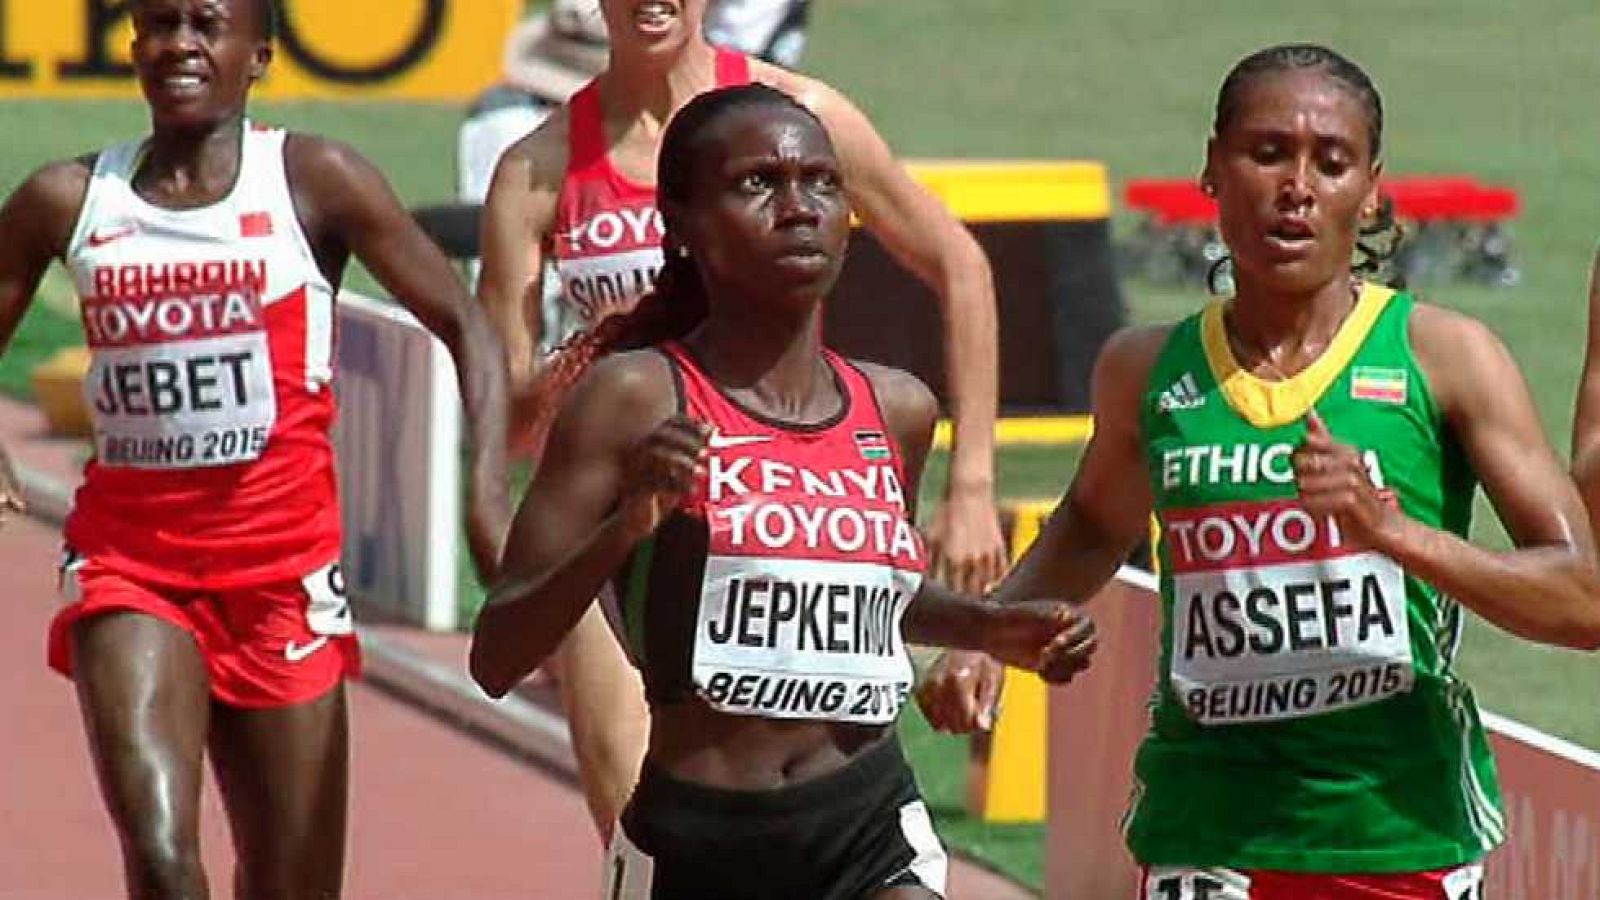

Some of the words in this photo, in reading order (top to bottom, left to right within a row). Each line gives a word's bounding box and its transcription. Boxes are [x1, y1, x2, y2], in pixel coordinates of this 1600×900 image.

[560, 207, 666, 251] TOY
[95, 259, 267, 297] BAHRAIN
[95, 352, 253, 416] JEBET
[105, 434, 195, 463] BEIJING
[203, 427, 266, 460] 2015
[708, 455, 905, 512] KENYA
[719, 503, 918, 561] TOYOTA
[1184, 573, 1395, 660] ASSEFA
[707, 672, 848, 714] BEIJING
[1187, 676, 1317, 719] BEIJING
[1326, 664, 1402, 706] 2015
